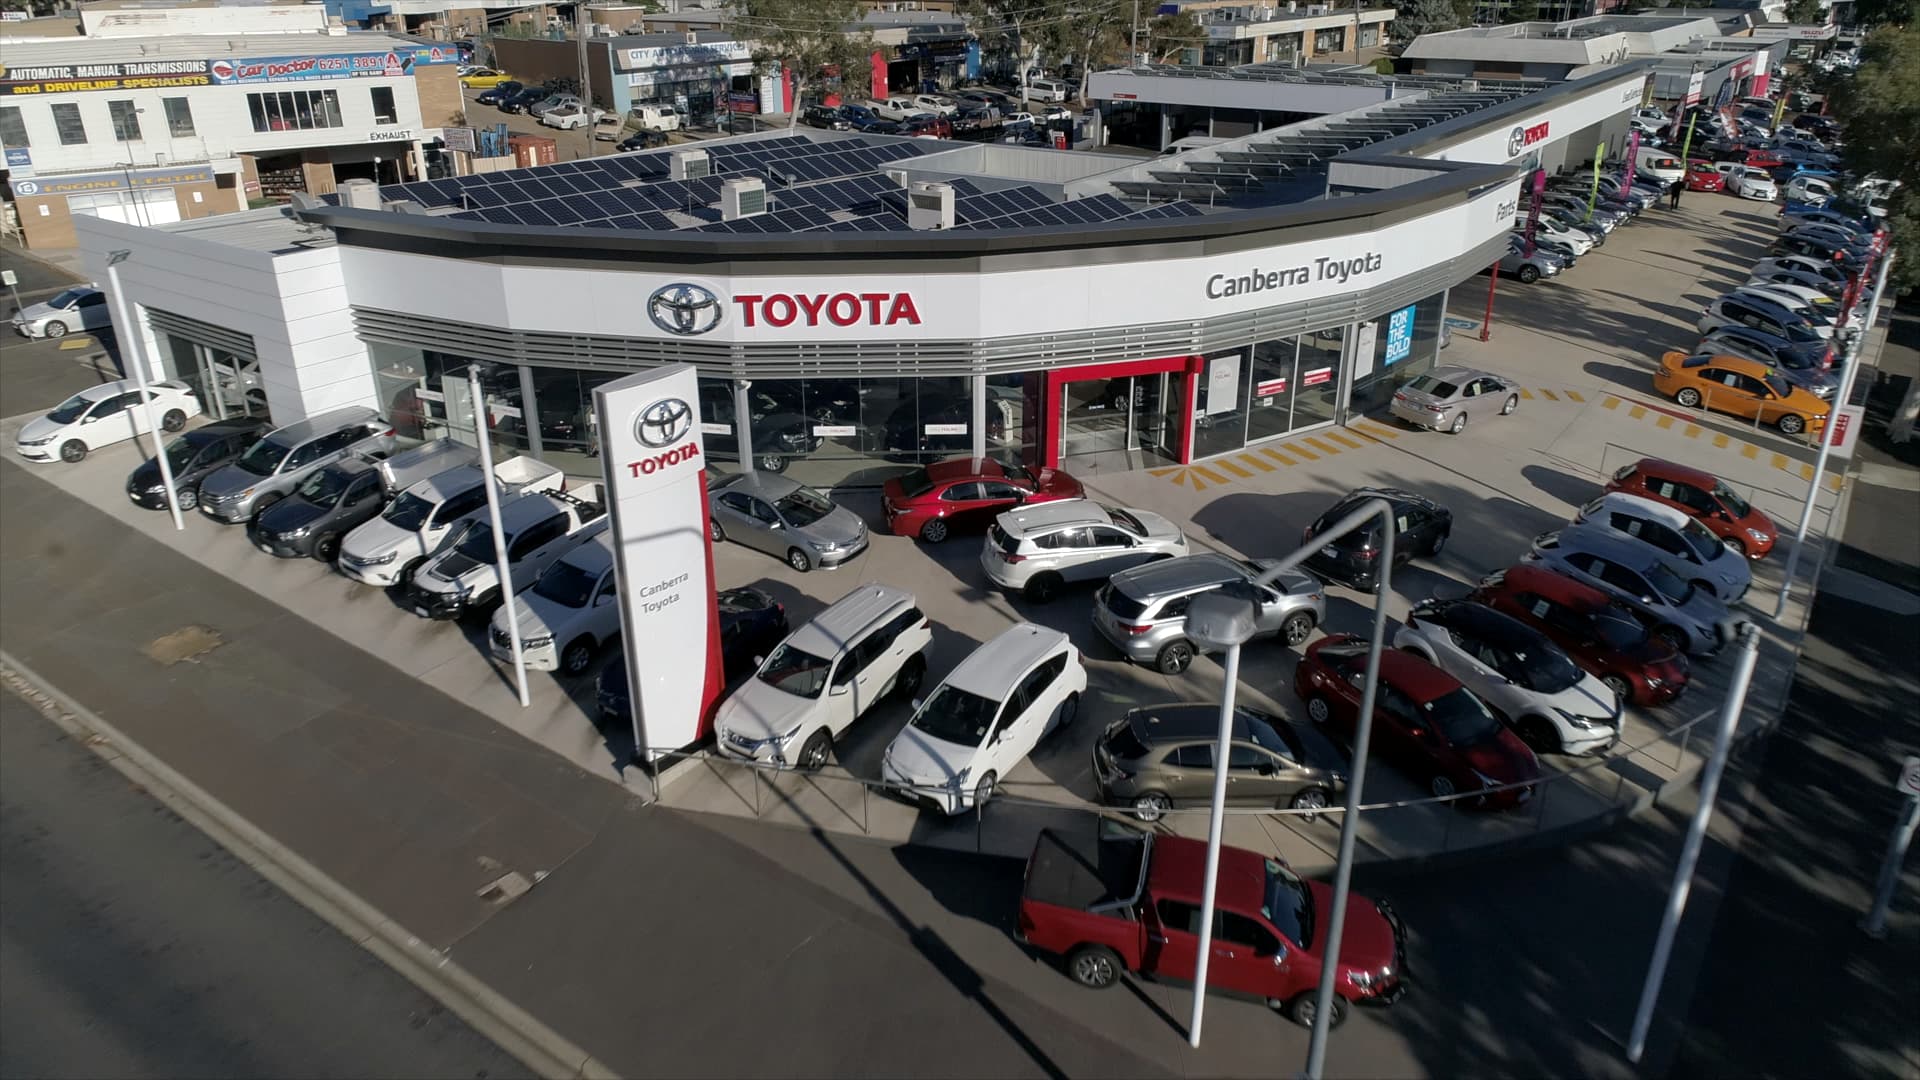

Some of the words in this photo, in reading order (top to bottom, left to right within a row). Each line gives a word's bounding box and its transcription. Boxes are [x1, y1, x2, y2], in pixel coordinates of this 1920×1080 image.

[319, 57, 350, 71] 6251
[353, 56, 384, 69] 3891
[631, 50, 649, 59] CITY
[653, 47, 677, 57] AUTO
[10, 67, 73, 81] AUTOMATIC,
[77, 65, 121, 77] MANUAL
[124, 61, 207, 75] TRANSMISSIONS
[13, 83, 40, 94] and
[44, 80, 118, 92] DRIVELINE
[123, 76, 209, 88] SPECIALISTS
[369, 131, 411, 141] EXHAUST
[43, 179, 119, 193] ENGINE
[130, 172, 207, 186] CENTRE
[1495, 198, 1516, 223] Parts
[1205, 264, 1310, 300] Canberra
[1314, 252, 1382, 285] Toyota
[733, 293, 921, 327] TOYOTA
[1390, 310, 1408, 330] FOR
[1390, 324, 1406, 343] THE
[1386, 337, 1410, 358] BOLD
[628, 442, 699, 478] TOYOTA
[639, 572, 689, 598] Canberra
[641, 592, 680, 614] Toyota
